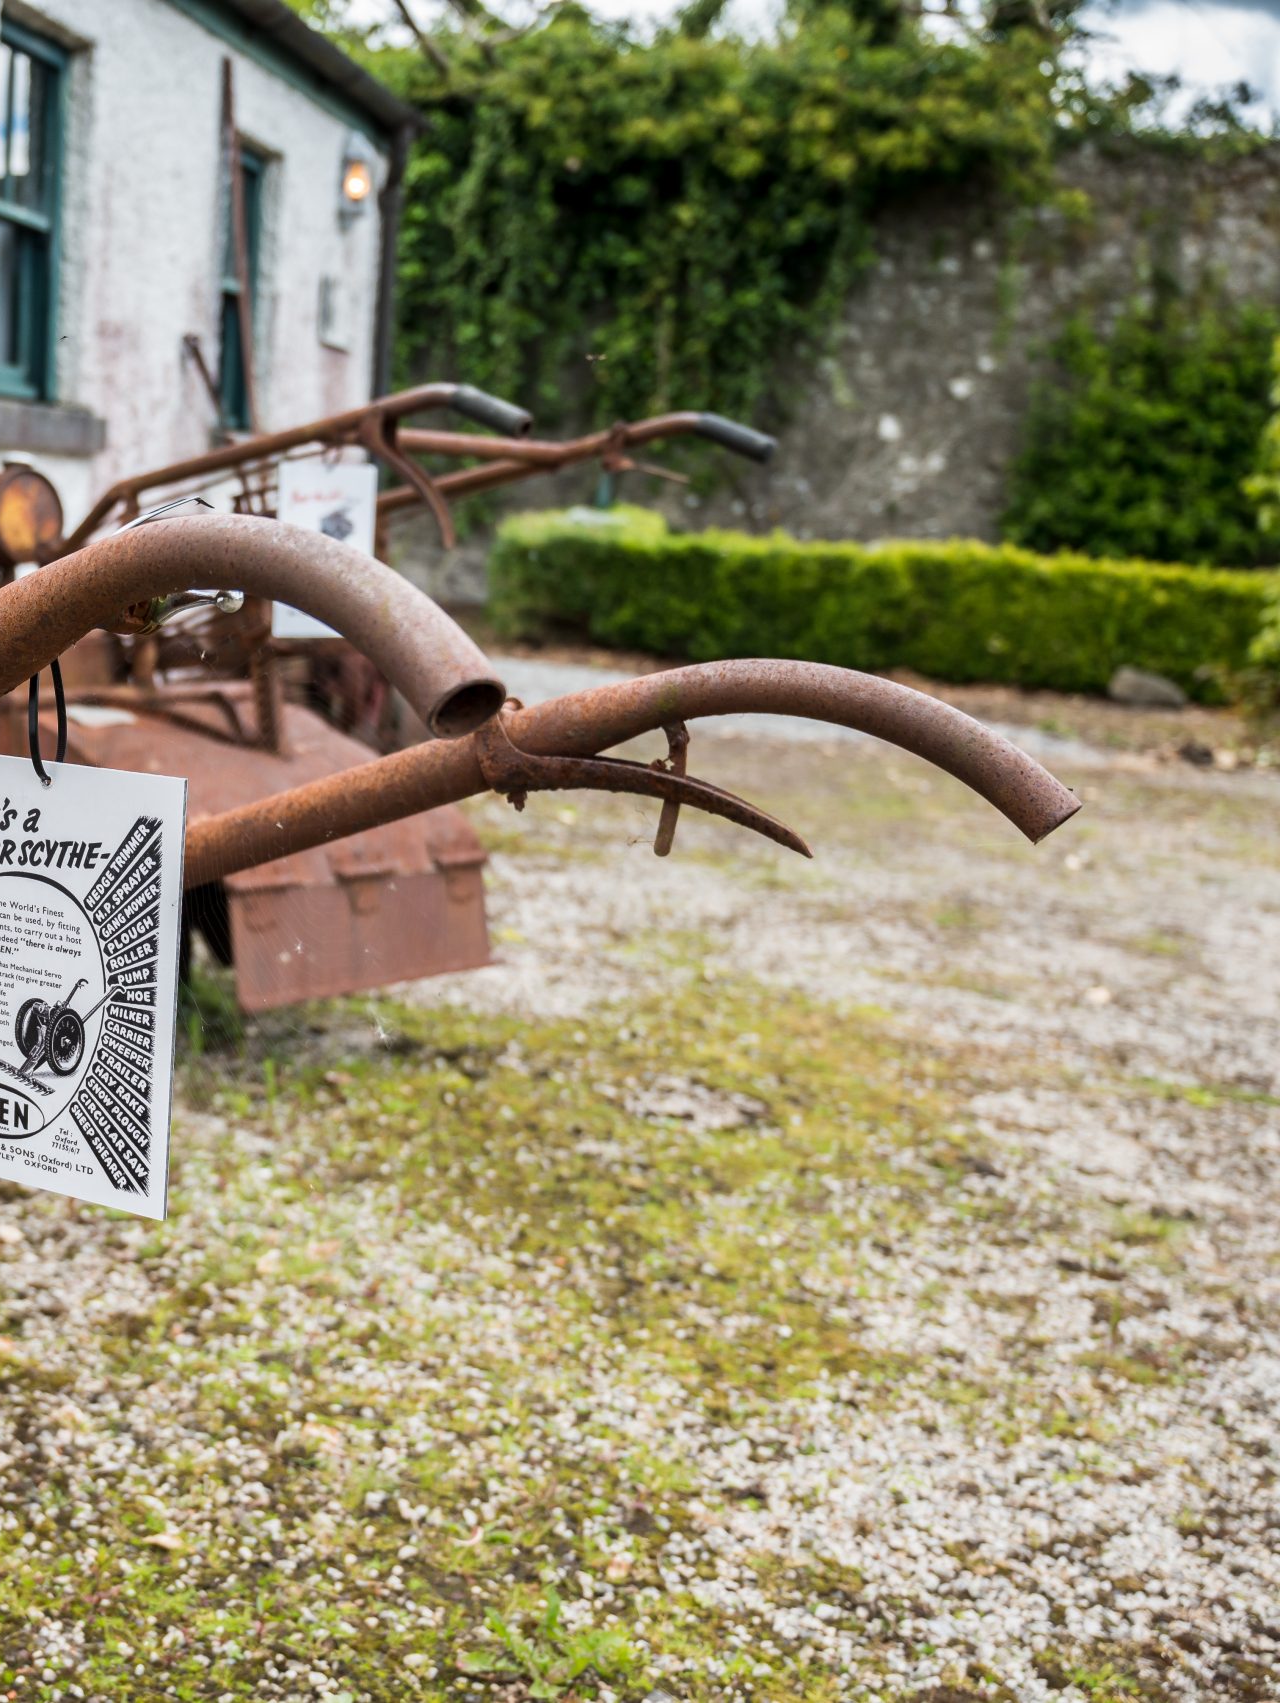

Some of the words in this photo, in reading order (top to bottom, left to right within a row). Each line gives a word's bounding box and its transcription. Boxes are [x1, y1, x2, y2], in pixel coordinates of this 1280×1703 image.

[23, 809, 41, 833] a
[86, 871, 114, 908] HEDGE
[111, 824, 150, 874] TRIMMER
[96, 901, 114, 923] H.P.
[113, 856, 156, 902] SPRAYER
[13, 913, 22, 922] be
[25, 917, 44, 927] used,
[46, 918, 56, 930] by
[58, 921, 81, 935] fitting
[42, 906, 64, 918] Finest
[102, 914, 126, 938] GANG
[125, 884, 159, 919] MOWER
[24, 928, 43, 940] carry
[66, 934, 82, 945] host
[108, 916, 154, 955] PLOUGH
[47, 943, 54, 951] is
[55, 945, 82, 958] always
[110, 942, 153, 970] ROLLER
[0, 971, 15, 980] track
[25, 976, 39, 984] give
[39, 980, 63, 989] greater
[10, 963, 43, 976] Mechanical
[44, 970, 62, 980] Servo
[118, 968, 150, 985] PUMP
[126, 990, 150, 1002] HOE
[110, 1006, 150, 1026] MILKER
[107, 1020, 150, 1050] CARRIER
[102, 1035, 150, 1071] SWEEPER
[100, 1051, 147, 1093] TRAILER
[94, 1064, 116, 1087] HAY
[116, 1086, 146, 1117] RAKE
[87, 1077, 113, 1106] SNOW
[111, 1106, 148, 1148] PLOUGH
[54, 1134, 78, 1146] Oxford
[71, 1104, 94, 1136] SHEEP
[92, 1136, 127, 1189] SHEARER
[80, 1091, 126, 1153] CIRCULAR
[123, 1150, 148, 1178] SAW
[10, 1143, 35, 1158] SONS
[38, 1154, 72, 1171] (Oxford)
[76, 1164, 94, 1175] LTD
[24, 1159, 58, 1174] OXFORD
